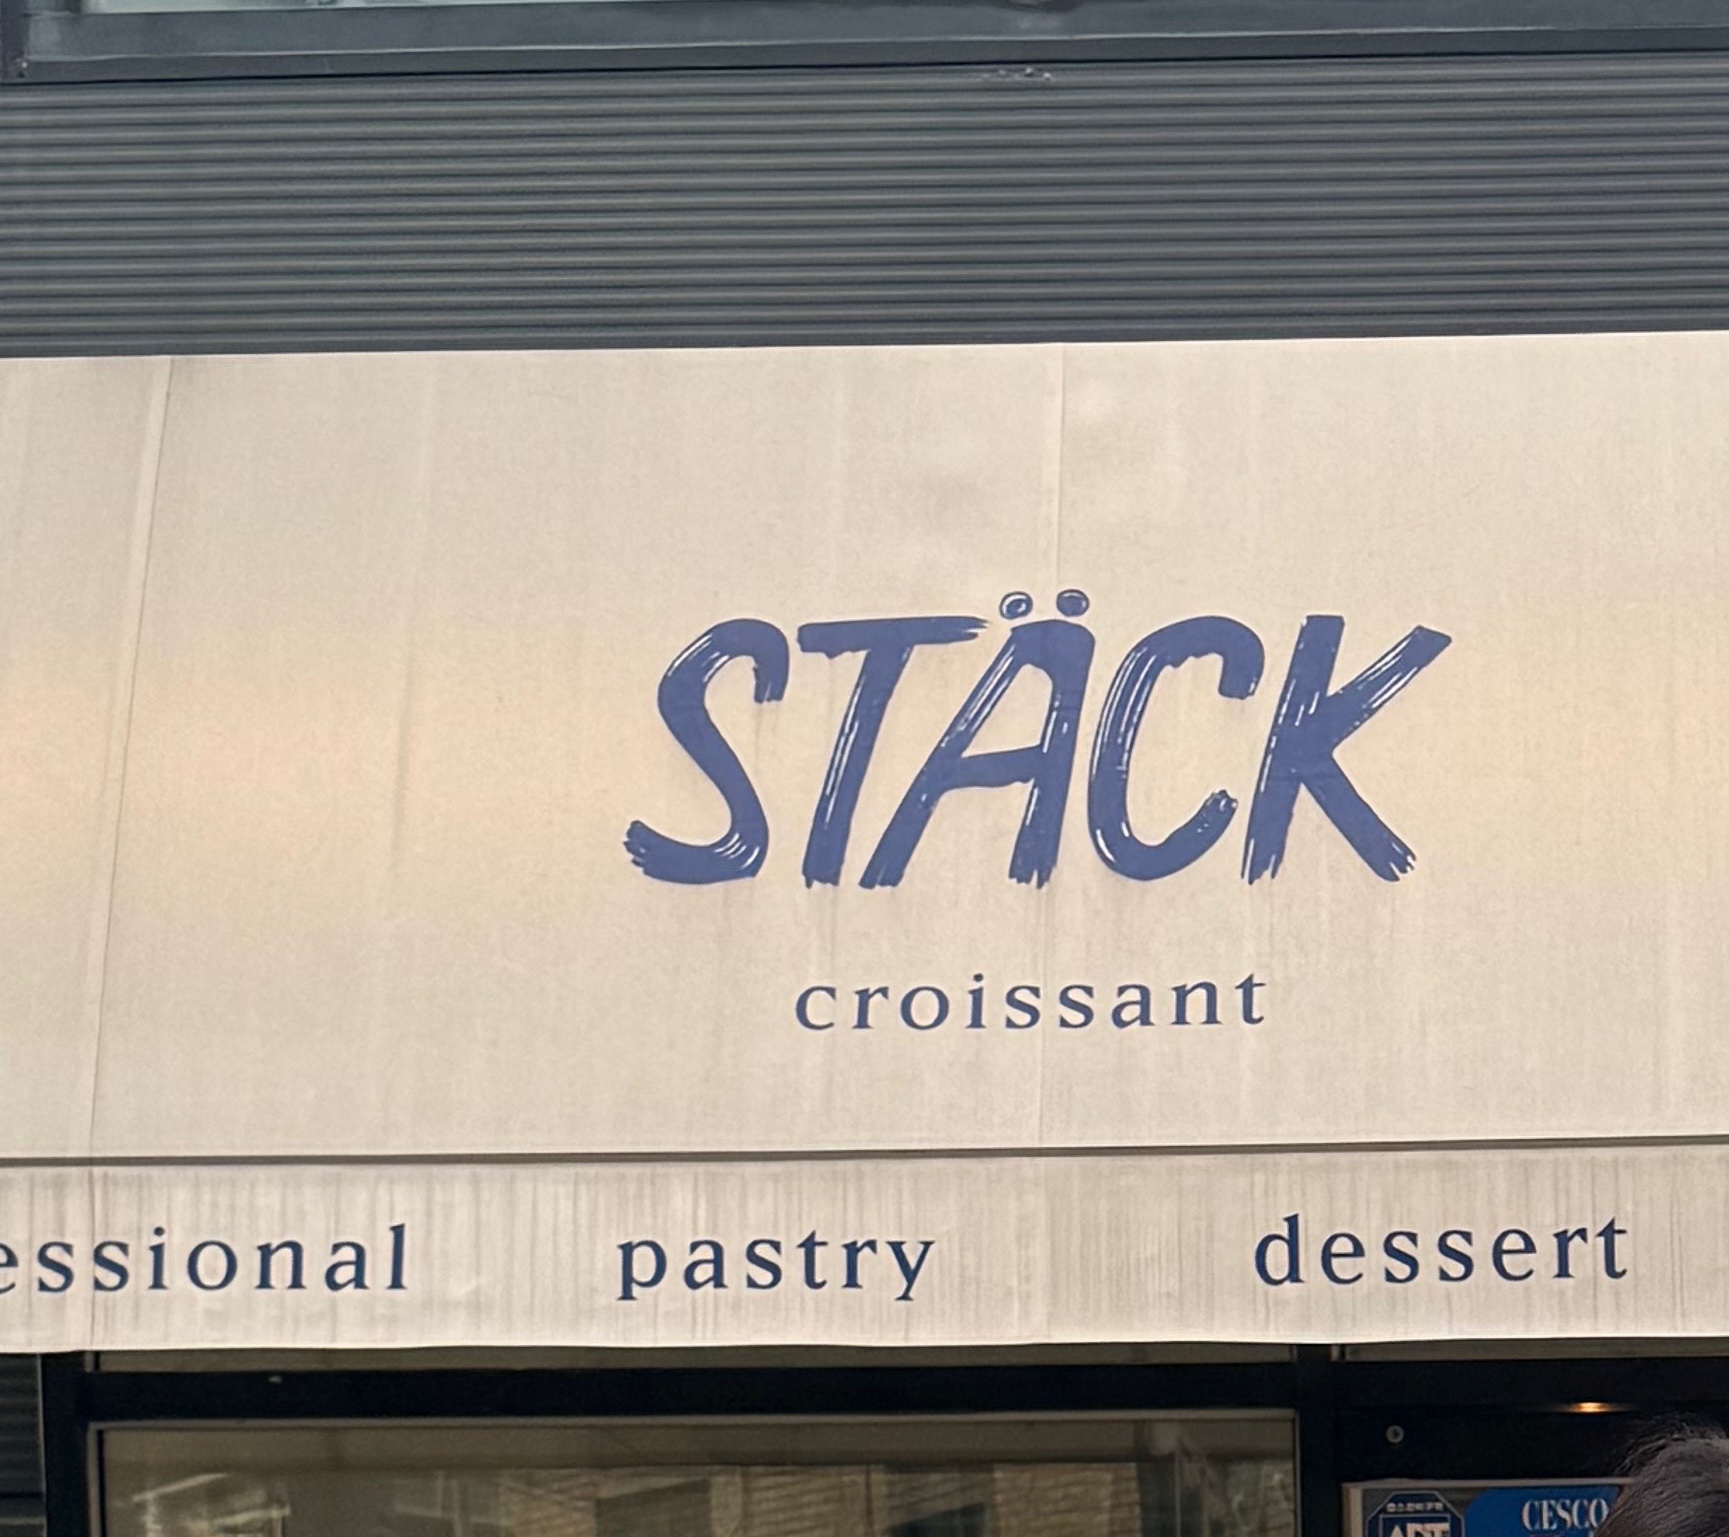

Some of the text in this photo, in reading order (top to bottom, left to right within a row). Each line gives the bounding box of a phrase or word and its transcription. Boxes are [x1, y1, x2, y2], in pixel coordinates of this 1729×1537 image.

[623, 588, 1452, 889] STÄCK
[795, 973, 1267, 1031] croissant
[617, 1228, 936, 1302] pastry
[1254, 1213, 1629, 1286] dessert
[1521, 1497, 1609, 1532] CESCO
